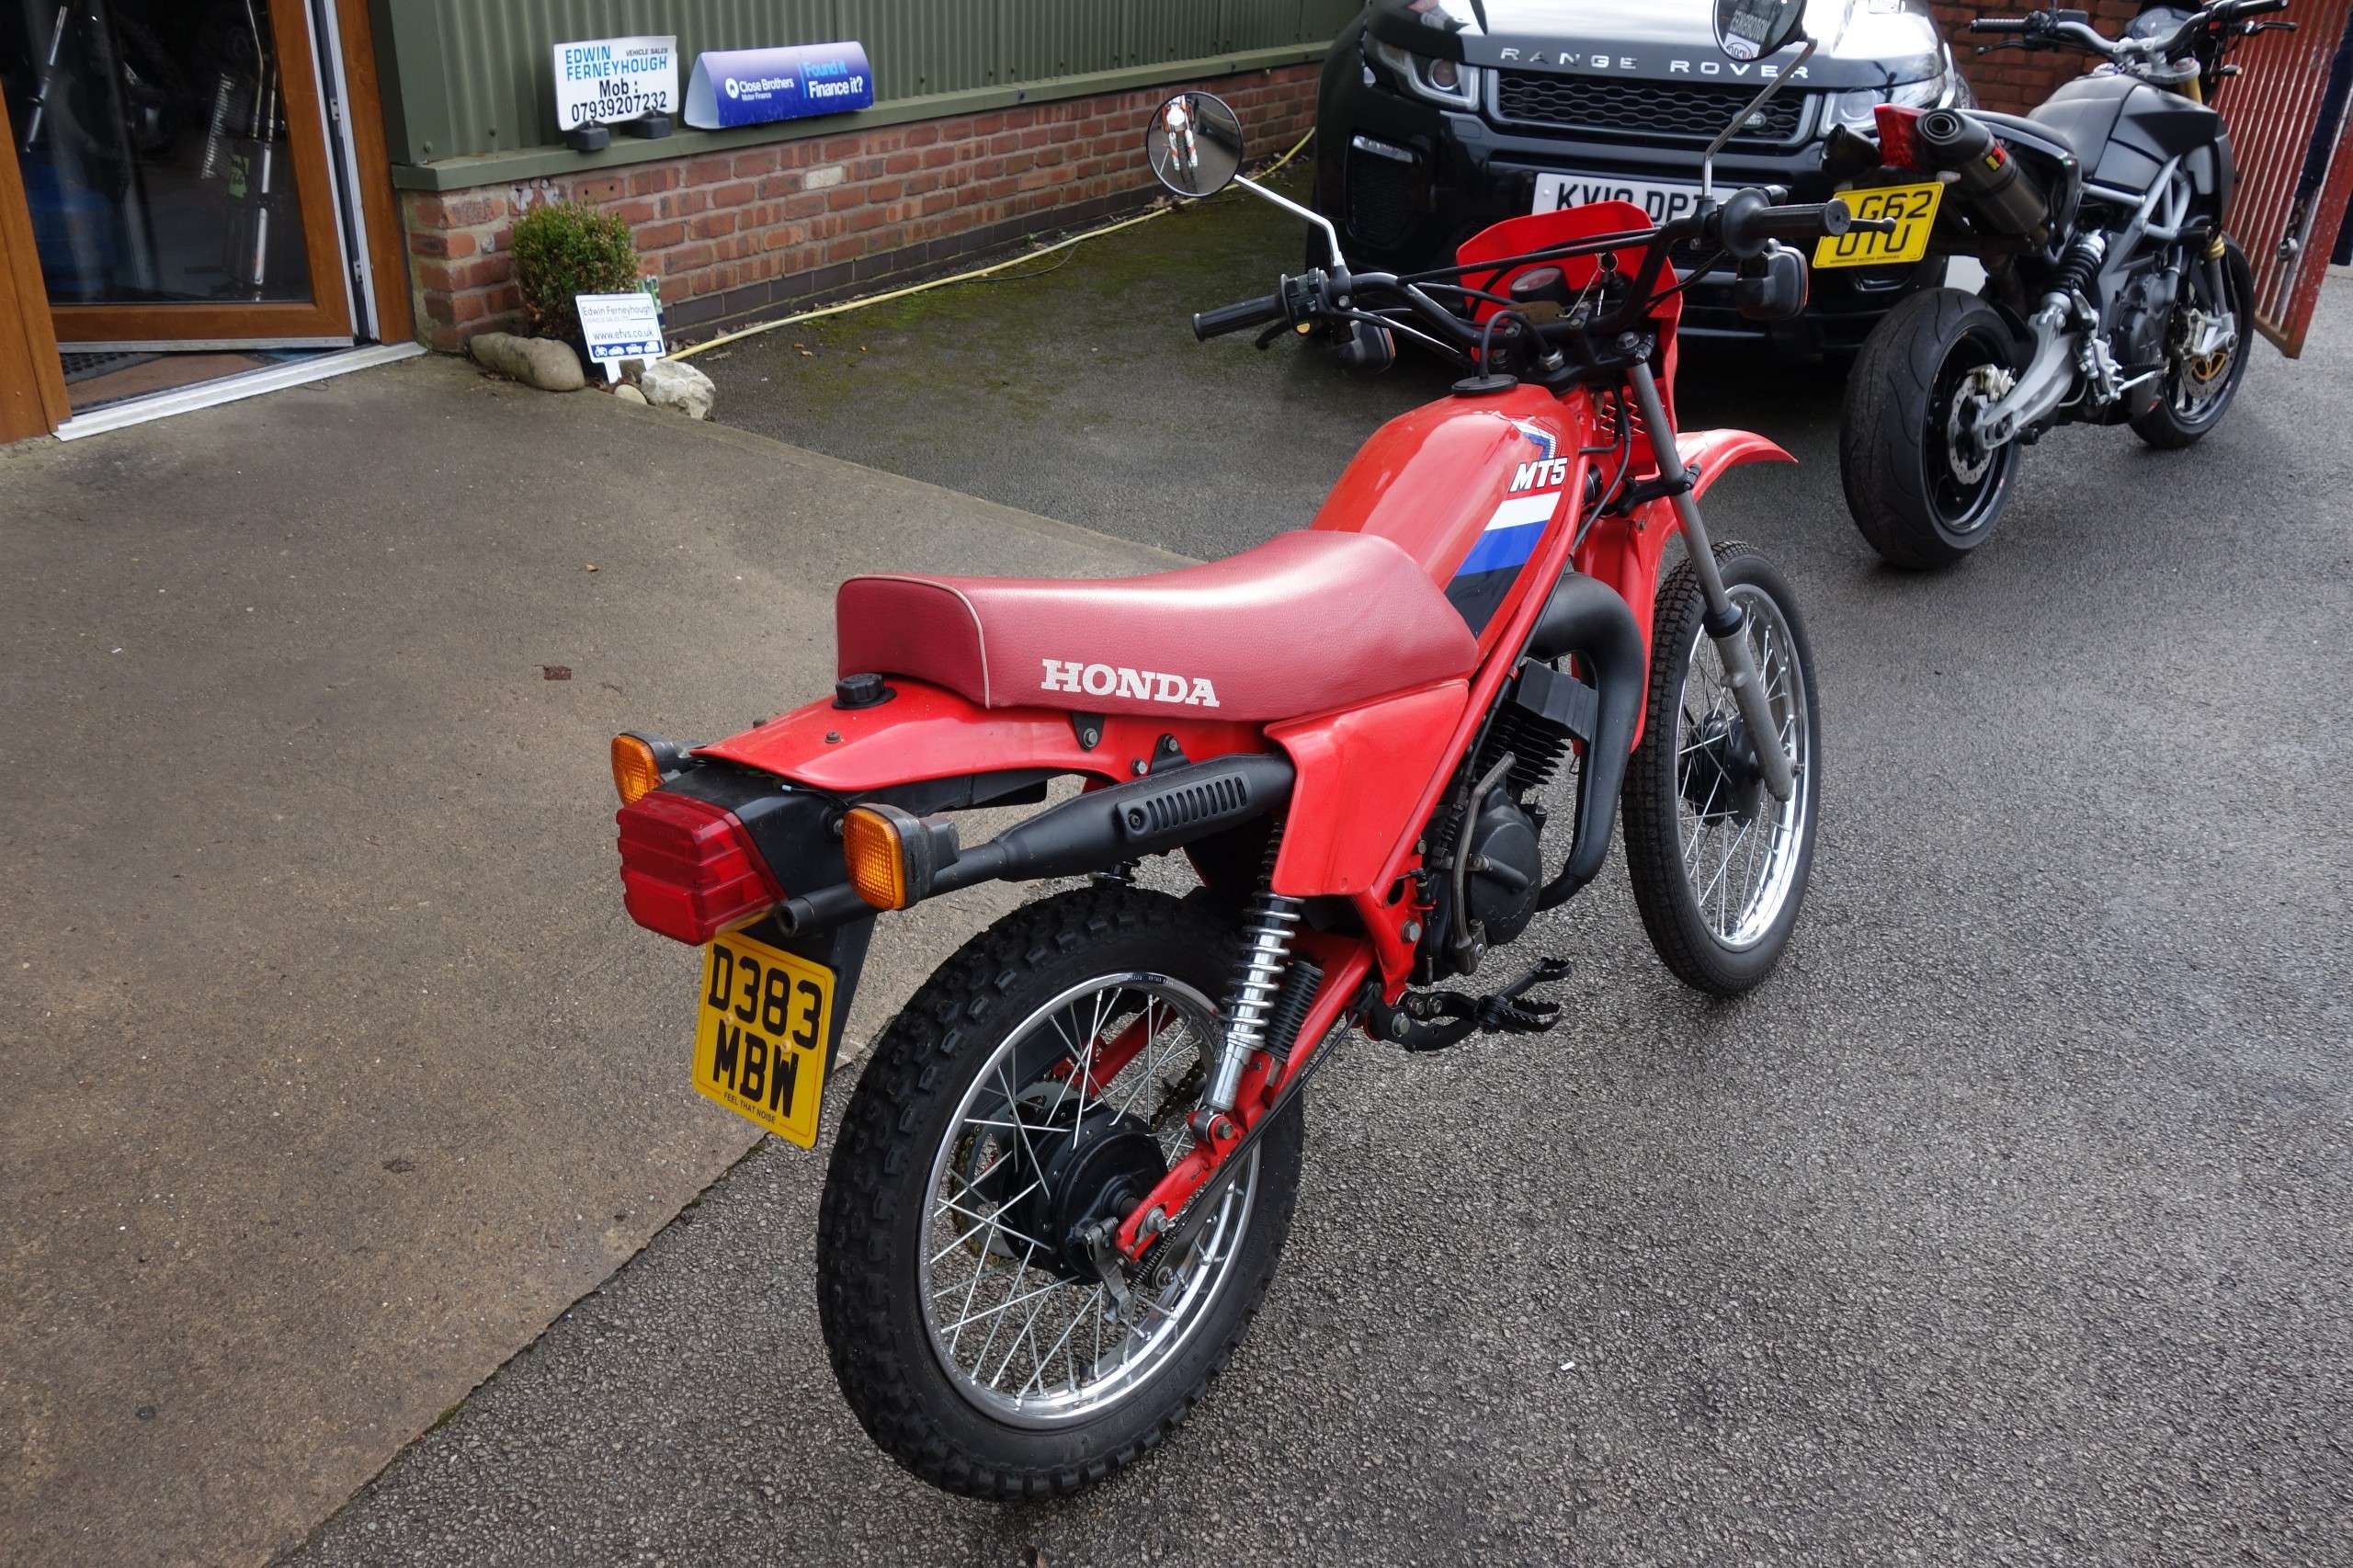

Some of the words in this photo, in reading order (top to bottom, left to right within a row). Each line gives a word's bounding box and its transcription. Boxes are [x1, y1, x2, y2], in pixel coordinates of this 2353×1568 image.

[566, 46, 610, 64] EDWIN
[626, 49, 648, 57] VEHICLE
[804, 61, 837, 77] Found
[838, 59, 847, 74] it
[1500, 48, 1637, 70] RANGE
[1670, 60, 1809, 78] ROVER
[567, 56, 666, 81] FERNEYHOUGH
[739, 80, 762, 93] Close
[763, 77, 794, 91] Brothers
[809, 79, 848, 98] Finance
[849, 75, 864, 93] it?
[572, 91, 666, 122] 07939207232
[1507, 456, 1569, 494] MT5
[1040, 658, 1220, 708] HONDA
[708, 943, 823, 1050] D383
[712, 1018, 800, 1119] MBW
[724, 1092, 738, 1106] FEEL
[740, 1100, 755, 1113] THAT
[756, 1108, 776, 1124] NOISE
